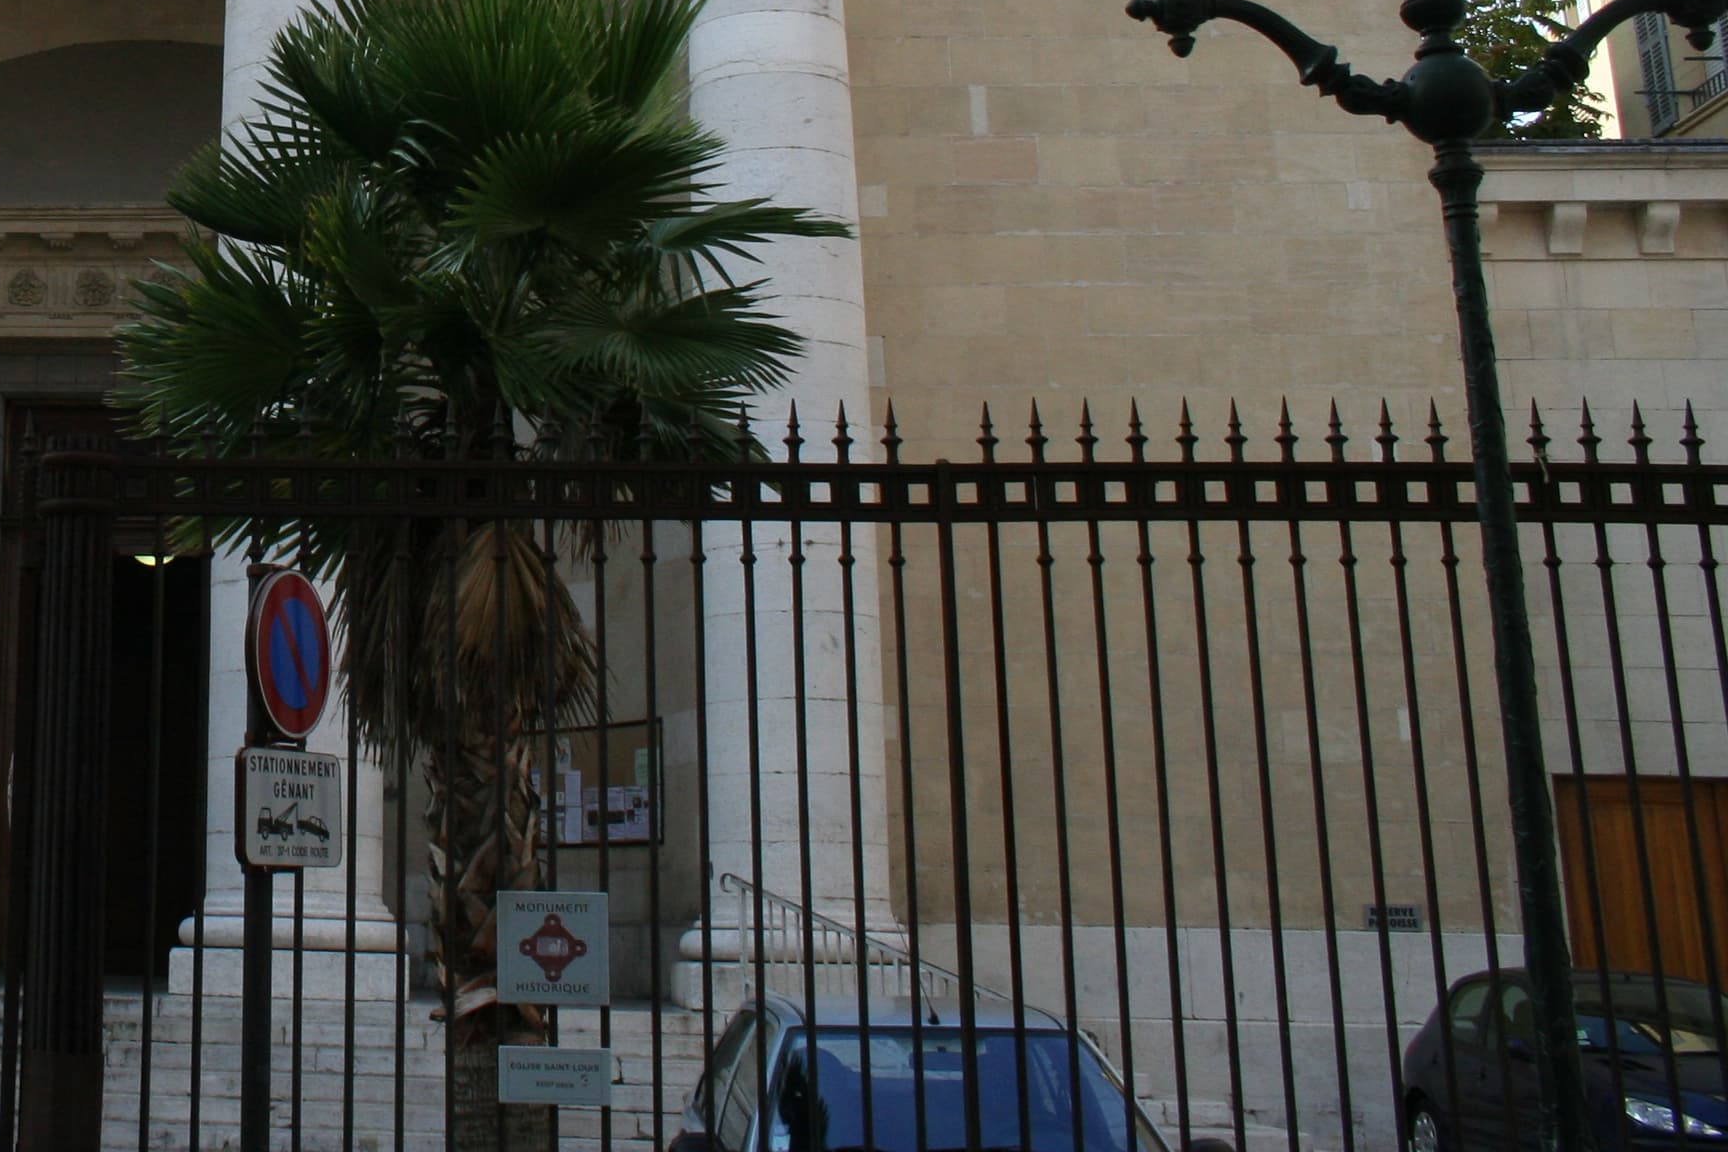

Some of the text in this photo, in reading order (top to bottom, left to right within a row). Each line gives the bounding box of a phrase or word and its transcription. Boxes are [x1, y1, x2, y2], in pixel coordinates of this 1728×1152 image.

[250, 756, 336, 778] STATIONNEMENT
[273, 778, 315, 800] GÊNANT
[291, 846, 308, 857] CODE
[310, 847, 329, 858] ROUTE
[515, 903, 589, 913] MONUMENT
[515, 983, 591, 994] HISTORIQUE
[544, 1063, 570, 1072] SAINT
[572, 1063, 600, 1073] LOUIS
